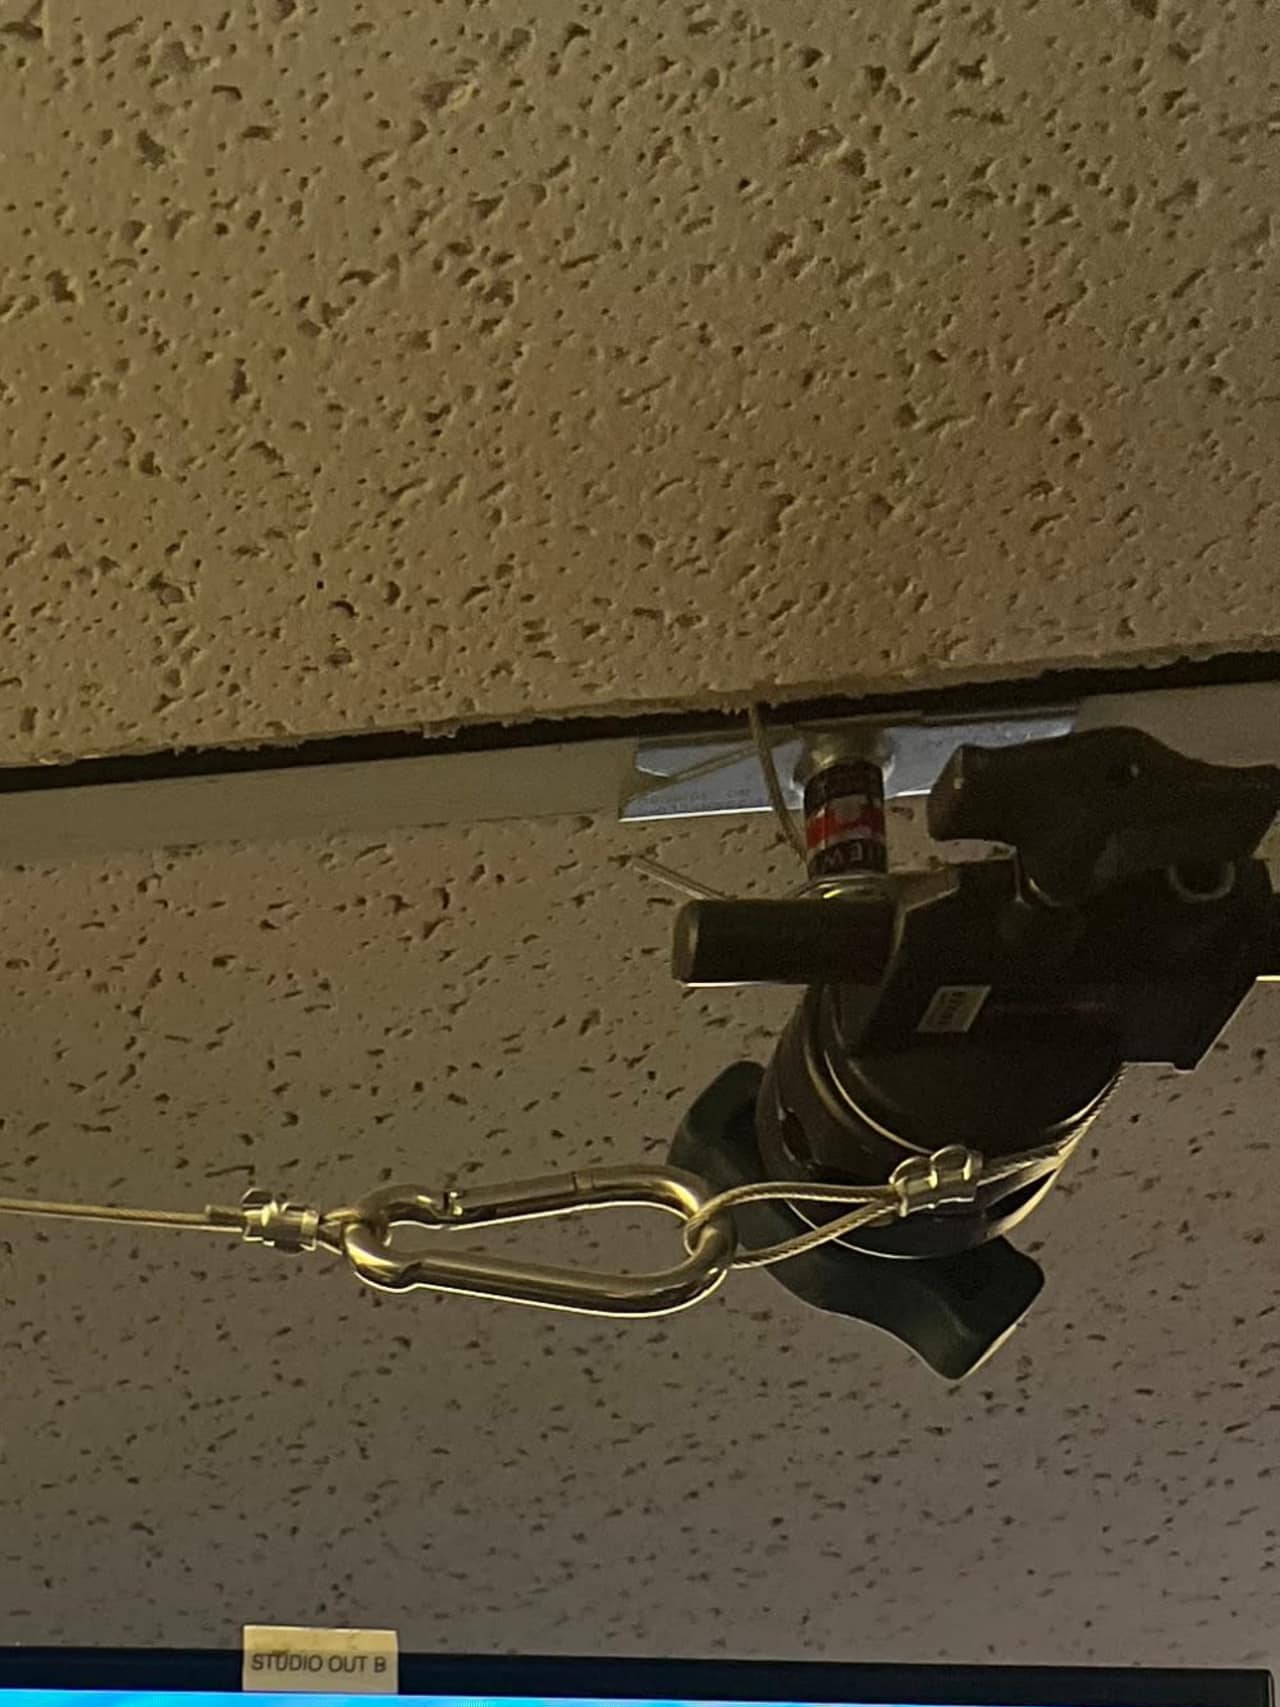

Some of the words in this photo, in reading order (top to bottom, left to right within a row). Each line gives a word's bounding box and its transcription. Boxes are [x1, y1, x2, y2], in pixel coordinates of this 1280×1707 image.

[251, 1653, 323, 1672] STUDIO
[328, 1655, 368, 1673] OUT
[374, 1656, 387, 1673] B
